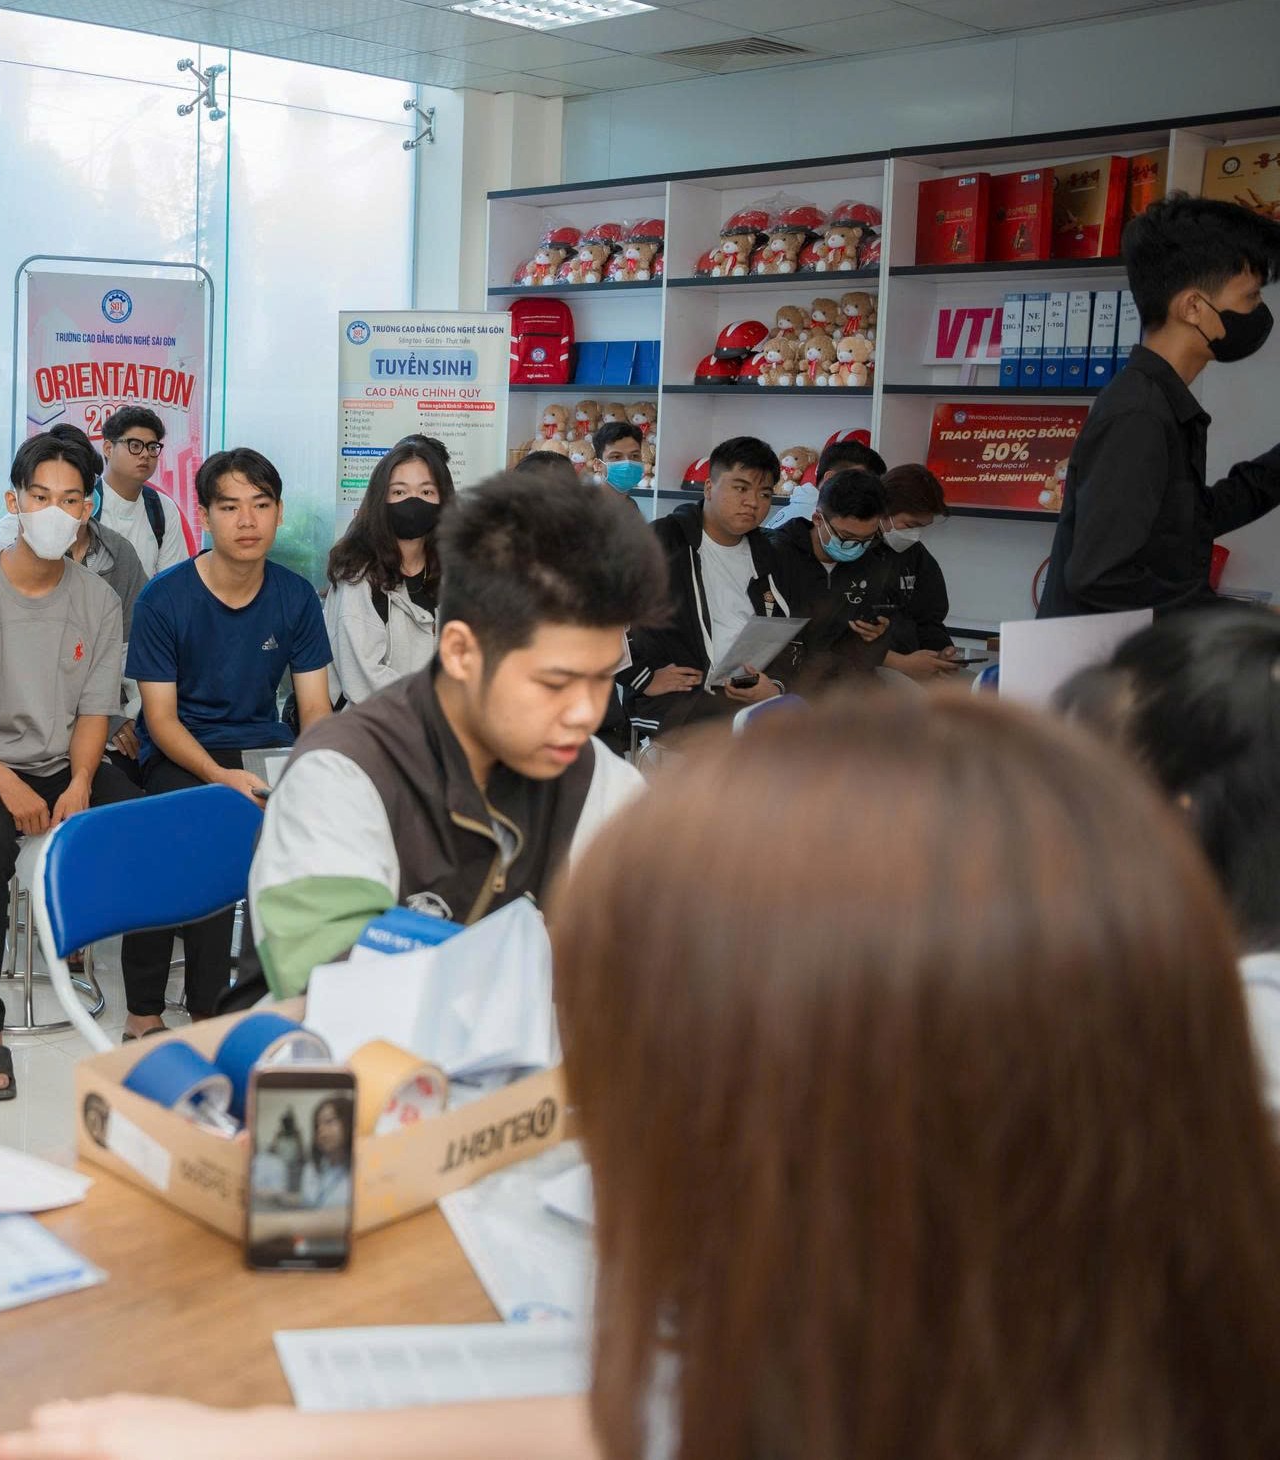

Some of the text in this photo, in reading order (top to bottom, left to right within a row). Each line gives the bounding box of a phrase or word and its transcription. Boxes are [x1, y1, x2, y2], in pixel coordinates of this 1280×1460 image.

[1028, 312, 1040, 320] NE
[372, 323, 504, 334] TRƯỜNG CAO ĐẲNG CÔNG NGHỆ SÀI GÒN
[1025, 324, 1042, 332] 2K7
[56, 330, 176, 347] TRƯỜNG CAO ĐẲNG CÔNG NGHỆ SÀI GÒN
[376, 352, 472, 376] TUYỂN SINH
[34, 362, 196, 410] ORIENTATION
[365, 384, 481, 400] CAO ĐẲNG CHÍNH QUY
[939, 431, 971, 440] TRAO
[973, 428, 1006, 442] TẶNG
[1006, 428, 1037, 441] HỌC
[982, 442, 1030, 462] 50%
[978, 472, 997, 482] TÂN
[998, 474, 1022, 482] SINH
[1023, 472, 1046, 482] VIÊN
